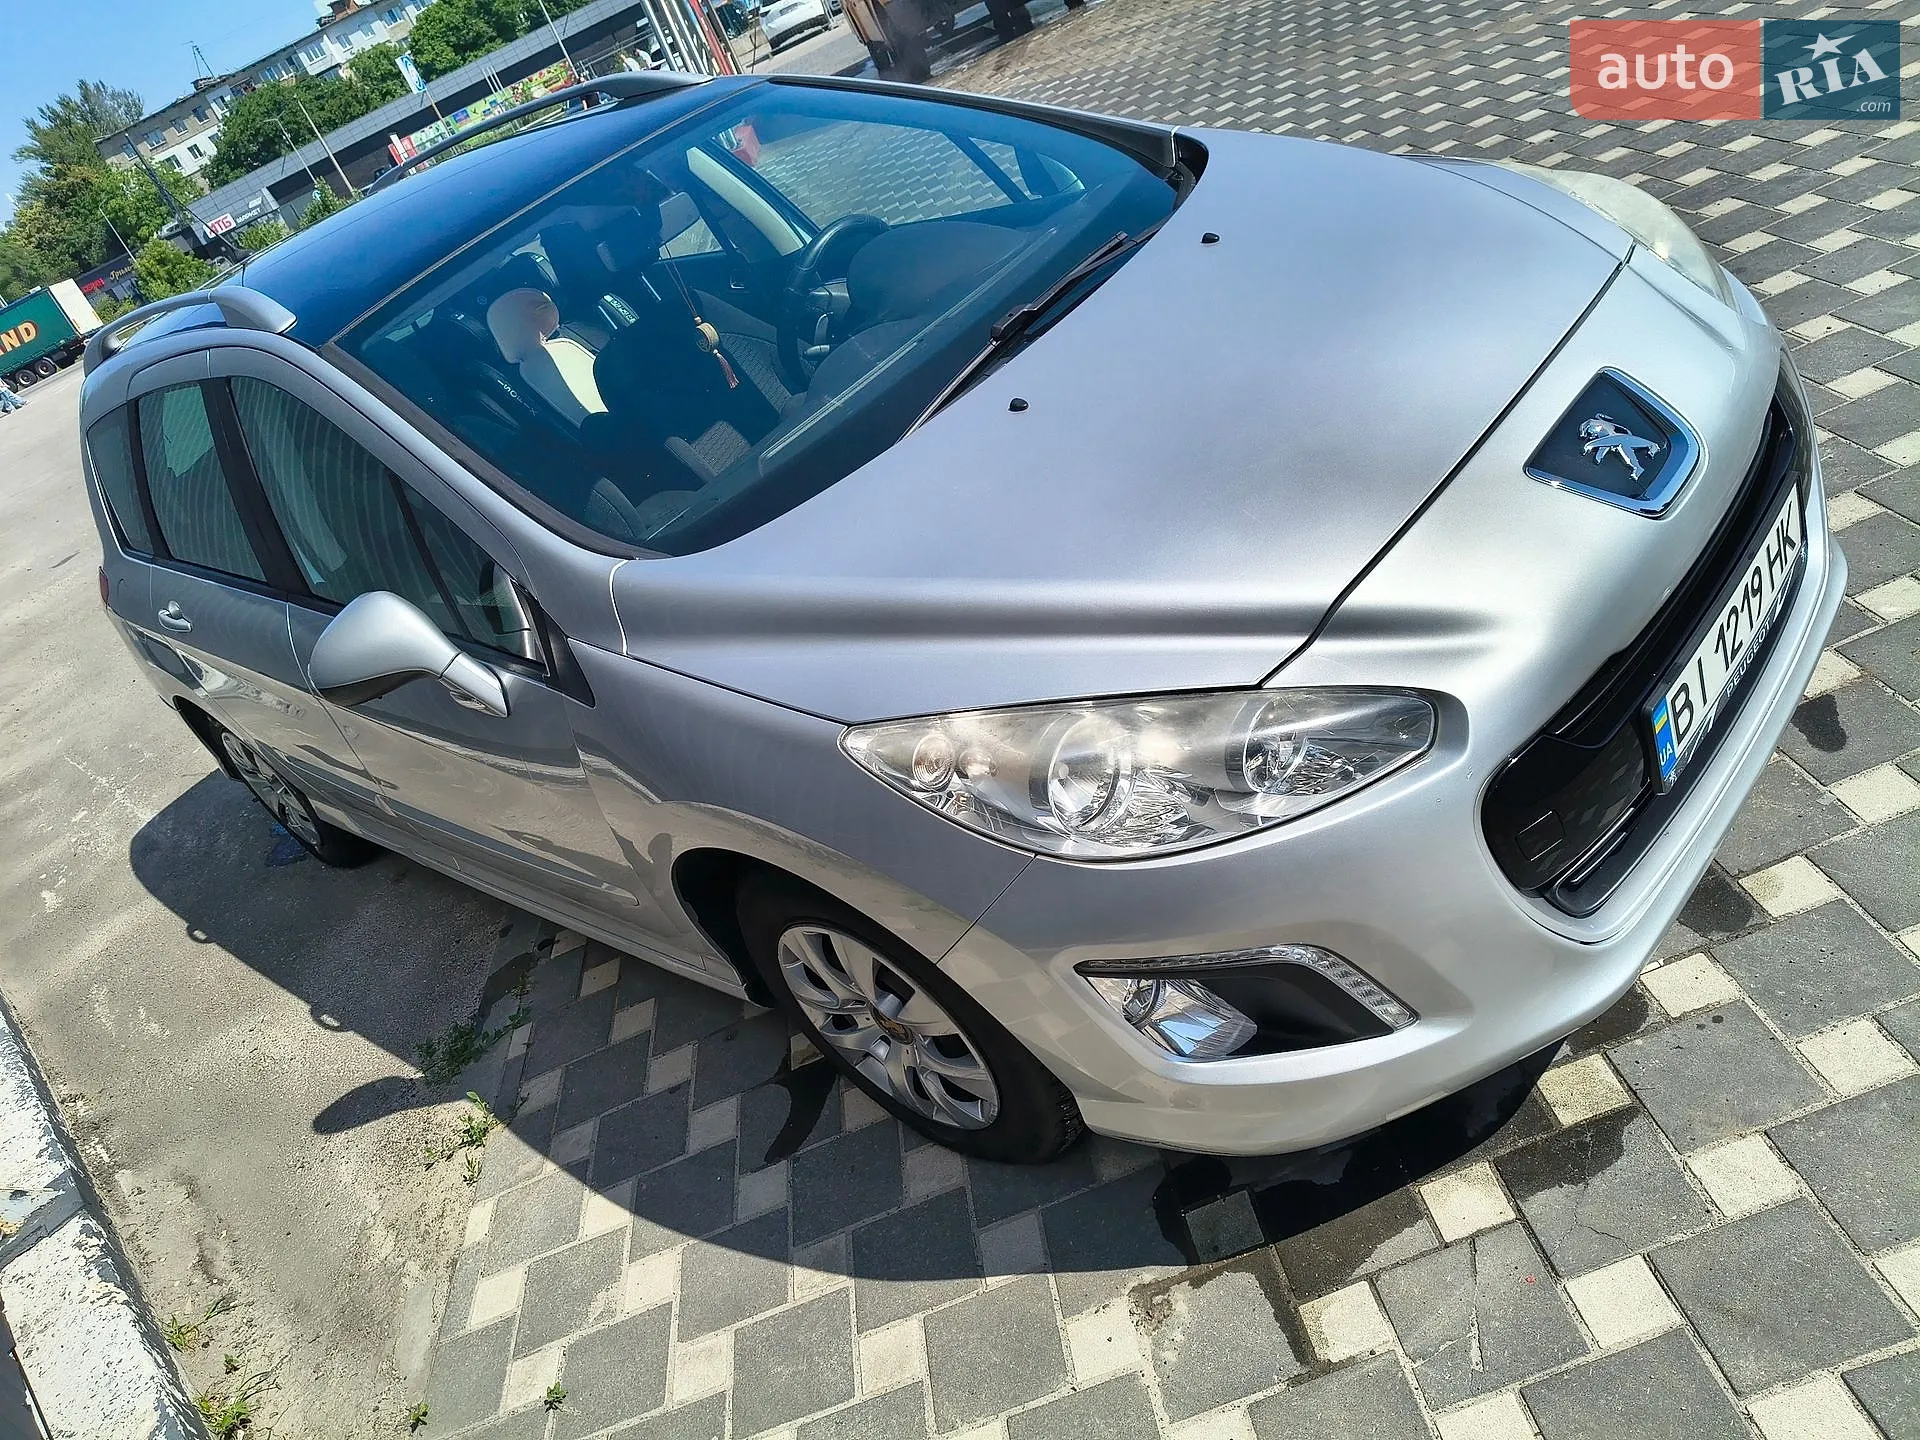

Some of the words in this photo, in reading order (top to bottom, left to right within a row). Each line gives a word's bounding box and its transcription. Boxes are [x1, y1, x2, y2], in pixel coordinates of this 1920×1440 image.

[0, 321, 38, 356] ND
[1670, 656, 1708, 747] BI
[1714, 565, 1763, 673] 1219
[1765, 500, 1797, 594] HK
[1726, 617, 1771, 698] PEUGEOT
[1660, 741, 1673, 766] UA
